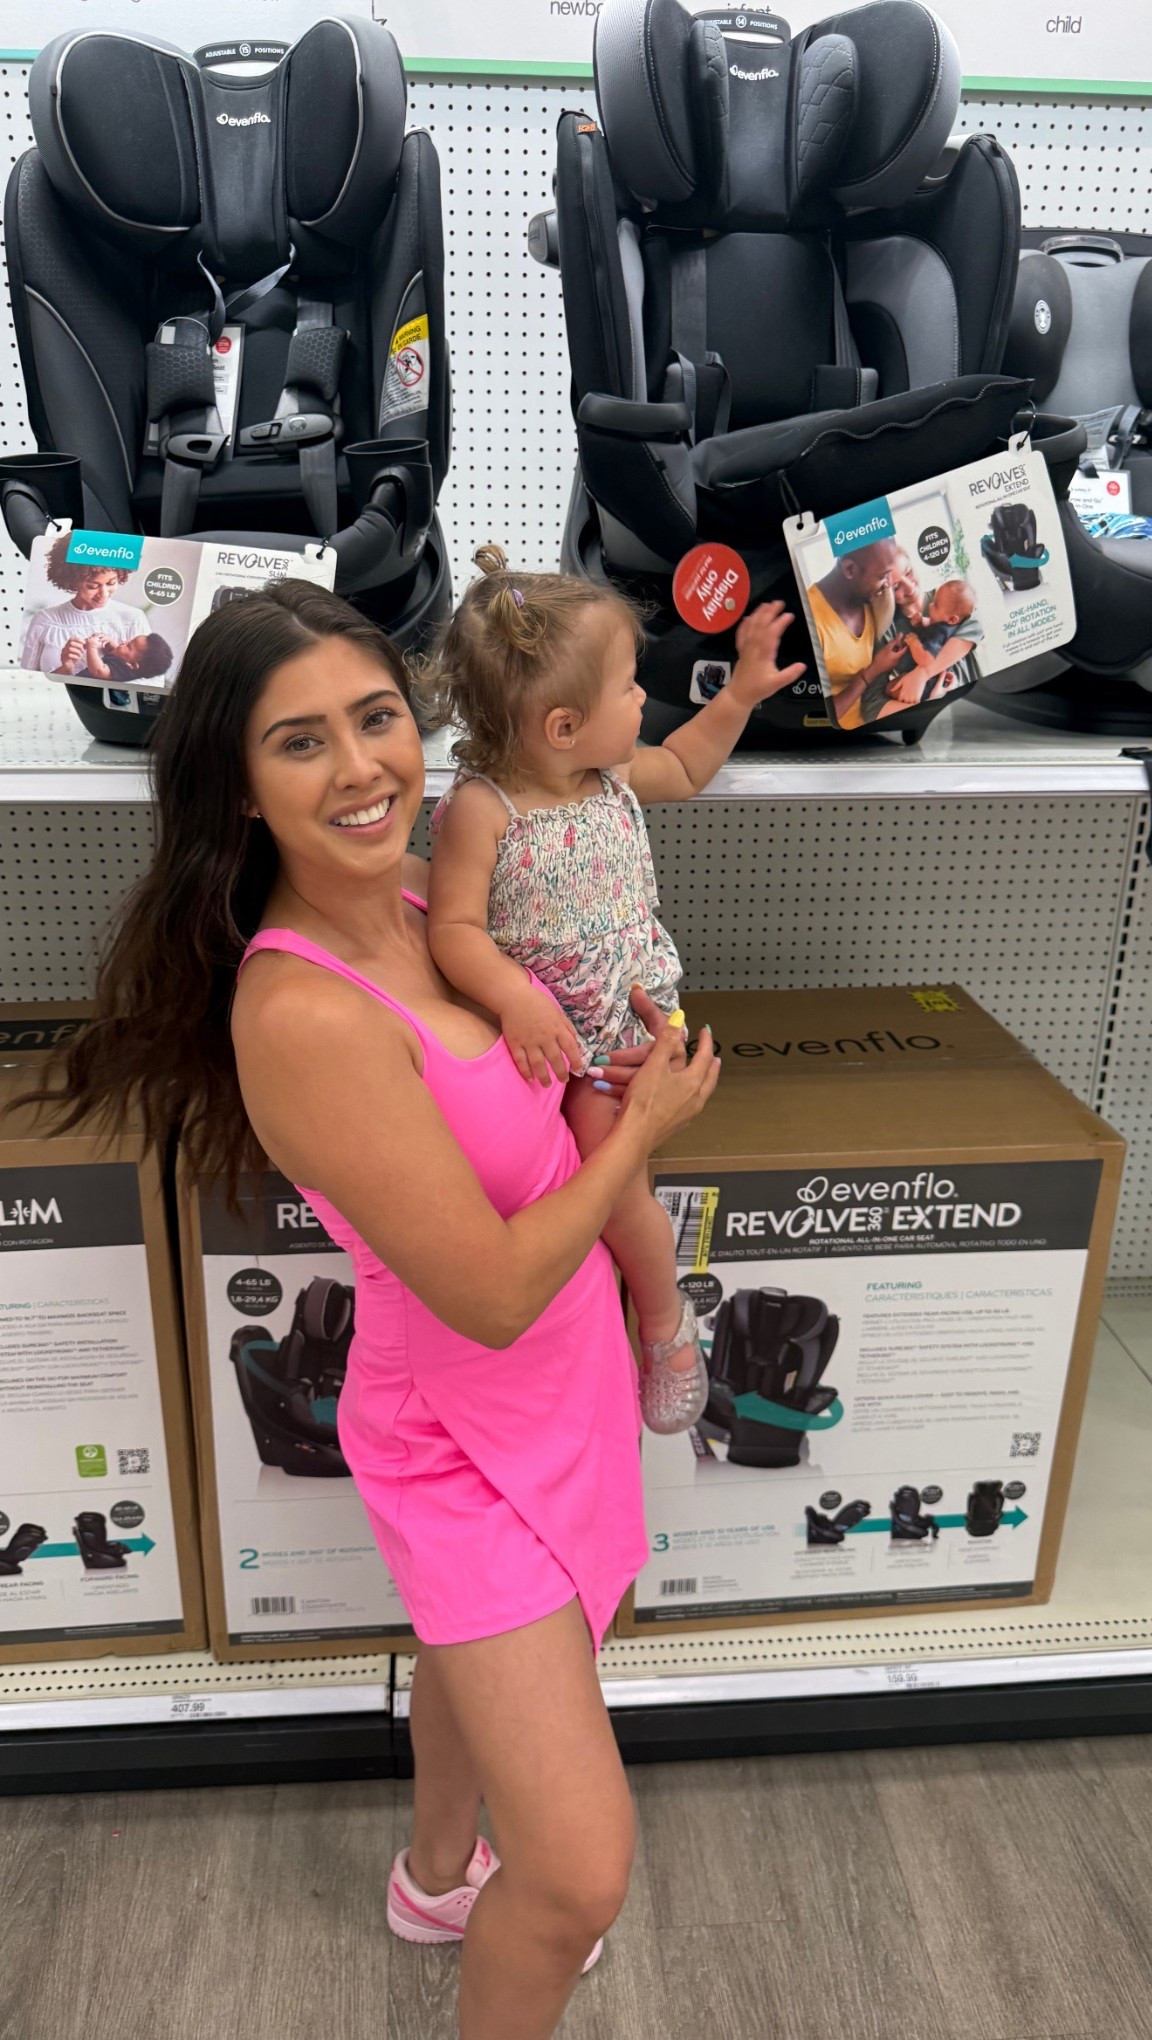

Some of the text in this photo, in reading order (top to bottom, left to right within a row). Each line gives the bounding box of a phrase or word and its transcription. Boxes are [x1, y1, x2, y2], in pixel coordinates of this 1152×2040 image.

[750, 20, 778, 29] POSITIONS
[1046, 15, 1082, 33] child
[205, 48, 236, 58] ADJUSTABLE
[737, 68, 776, 80] evenflo
[228, 112, 268, 127] evenflo
[968, 466, 1021, 496] REVOLVE
[1004, 478, 1029, 492] EXTEND
[845, 517, 888, 541] evenflo
[925, 532, 939, 542] FITS
[87, 546, 134, 560] evenflo
[919, 538, 949, 554] CHILDREN
[923, 547, 949, 561] 4-120 LB
[217, 552, 282, 570] REVOLVE
[146, 581, 181, 590] CHILDREN
[696, 568, 739, 622] Display only
[1020, 605, 1056, 624] ROTATION
[1008, 613, 1056, 639] IN ALL MODES
[732, 1031, 941, 1057] evenflo
[831, 1172, 955, 1202] evenflo
[0, 1197, 63, 1226] LIM
[277, 1202, 320, 1229] RE
[726, 1205, 868, 1239] REVOLVE
[868, 1206, 883, 1232] 360
[891, 1202, 1022, 1231] EXTEND
[746, 1247, 792, 1255] TOUT-EN-UN
[958, 1239, 995, 1247] ROTATIVO
[809, 1237, 854, 1245] ROTATIONAL
[866, 1281, 922, 1291] FEATURING
[652, 1533, 669, 1552] 3
[239, 1548, 259, 1569] 2
[171, 1702, 205, 1712] 407.99
